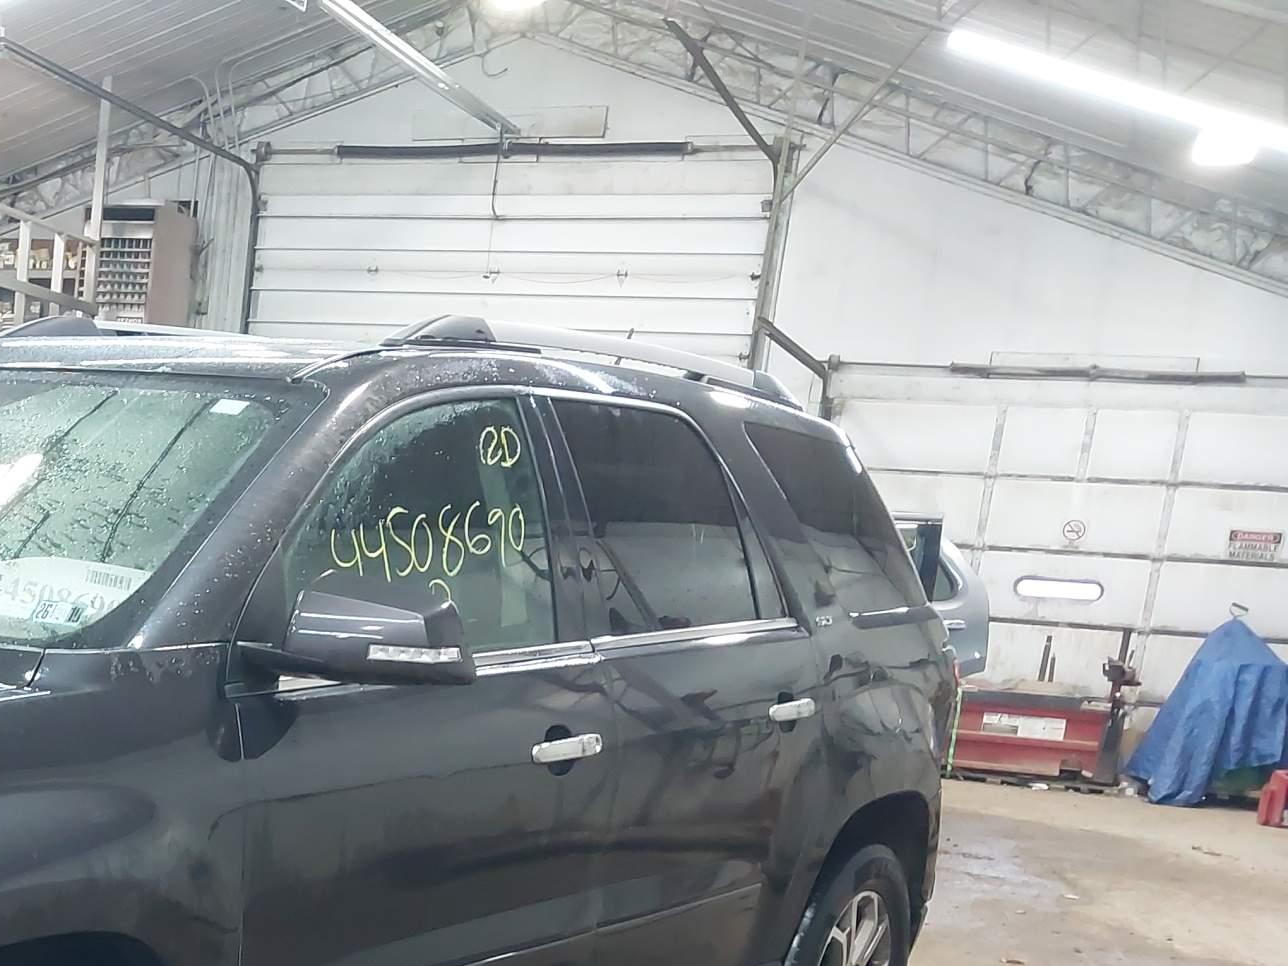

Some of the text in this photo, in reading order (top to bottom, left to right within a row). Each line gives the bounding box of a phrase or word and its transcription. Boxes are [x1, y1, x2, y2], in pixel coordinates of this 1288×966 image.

[331, 500, 525, 583] 44508690
[1237, 532, 1274, 542] DANGER
[1228, 543, 1279, 552] FLAMMABLE
[1229, 551, 1275, 561] MATERIALS
